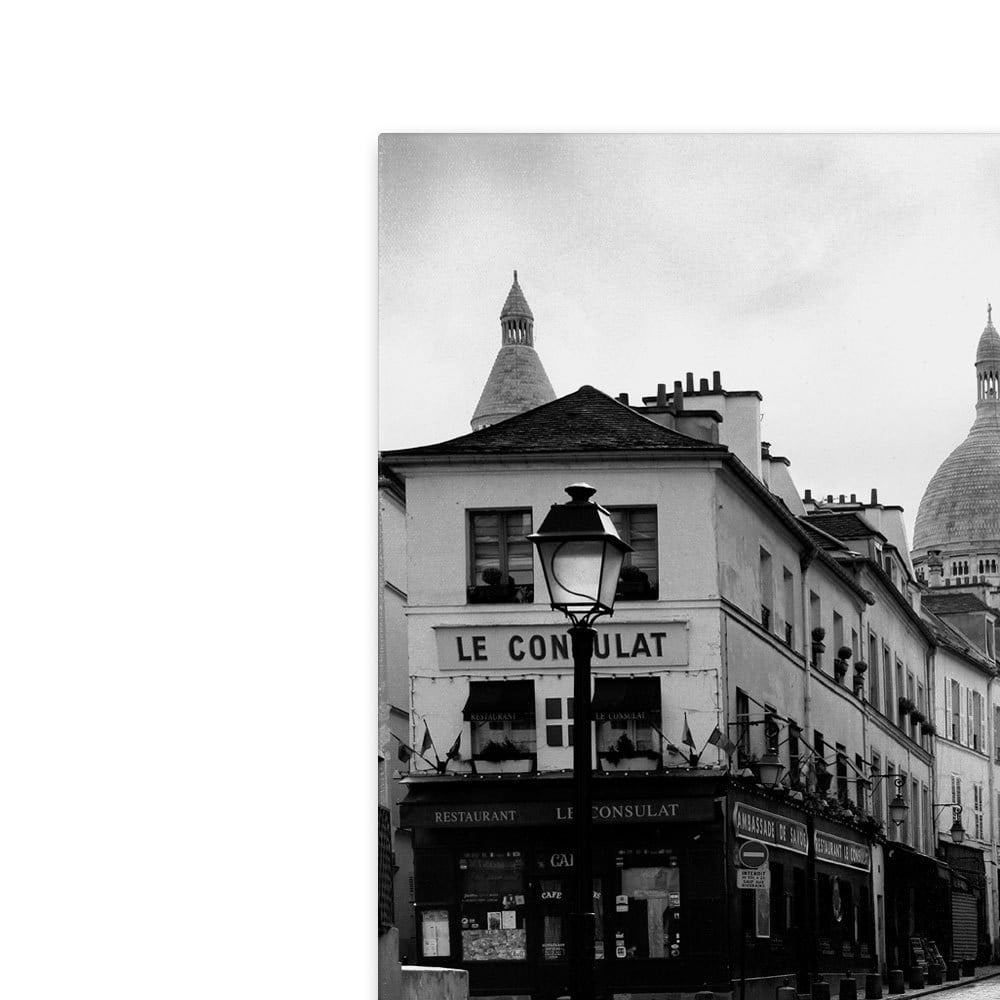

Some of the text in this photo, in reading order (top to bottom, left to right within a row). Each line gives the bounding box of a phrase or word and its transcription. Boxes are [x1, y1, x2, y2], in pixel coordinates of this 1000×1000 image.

[456, 632, 667, 661] LE CONULAT
[595, 711, 606, 720] LE
[435, 810, 517, 823] RESTAURANT
[737, 811, 775, 838] AMBASSADE
[779, 823, 787, 842] DE
